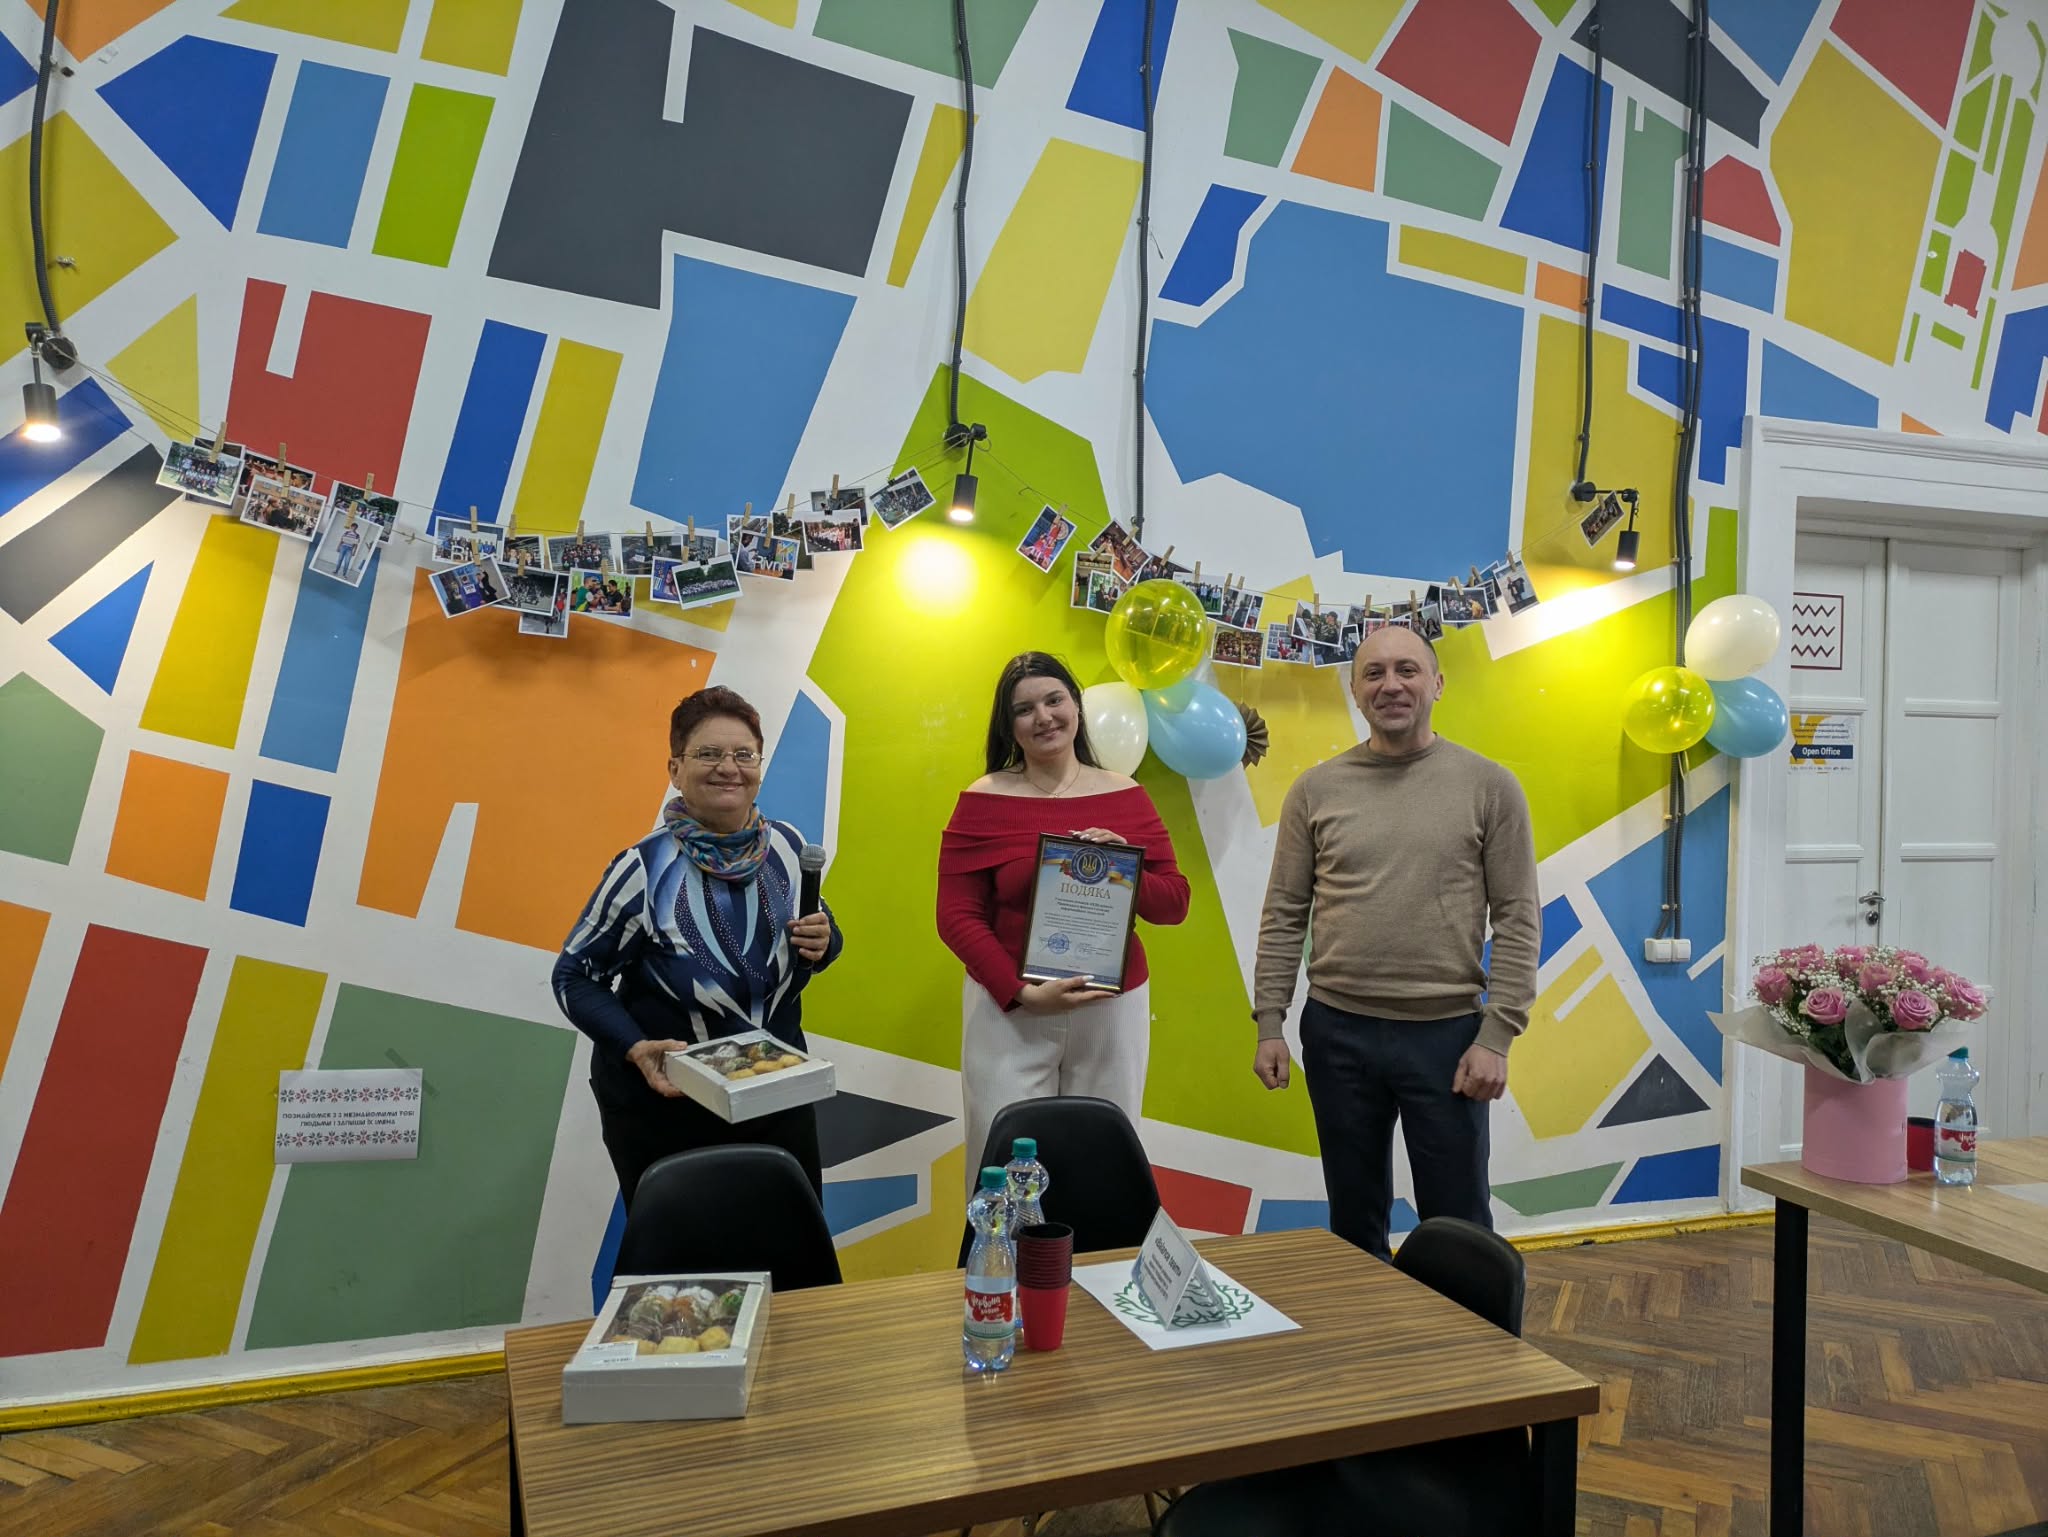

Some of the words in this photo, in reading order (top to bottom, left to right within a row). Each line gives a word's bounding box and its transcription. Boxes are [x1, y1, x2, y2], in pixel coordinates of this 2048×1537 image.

[1802, 747, 1820, 756] Open
[1820, 746, 1841, 756] Office
[1060, 882, 1111, 899] ПОДЯКА
